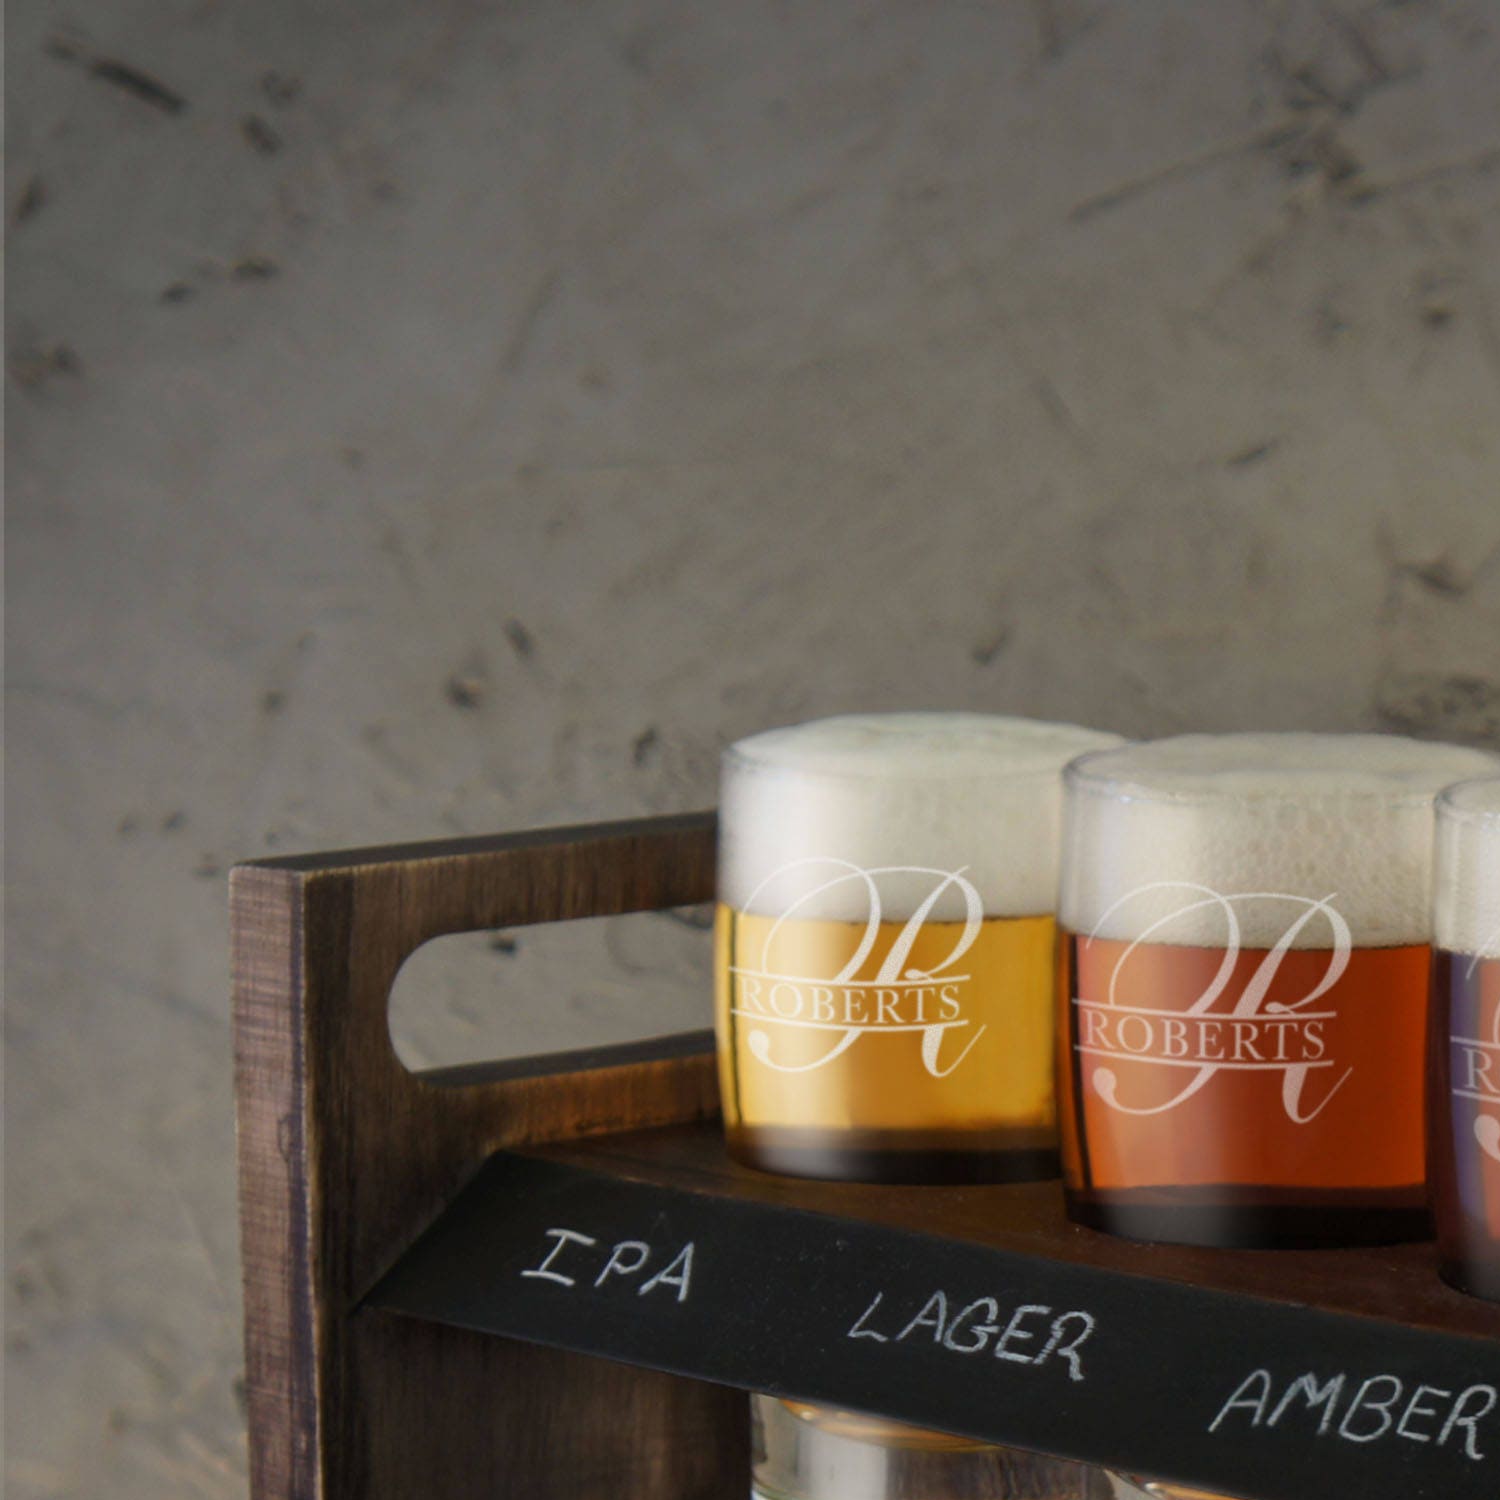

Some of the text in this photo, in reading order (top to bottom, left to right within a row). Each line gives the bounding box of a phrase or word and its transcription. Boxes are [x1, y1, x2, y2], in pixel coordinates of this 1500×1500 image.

[740, 976, 961, 1025] ROBERTS
[1084, 1008, 1325, 1061] ROBERTS
[519, 1227, 695, 1302] IPA
[846, 1289, 1096, 1382] LAGER
[1208, 1368, 1498, 1461] AMBER
